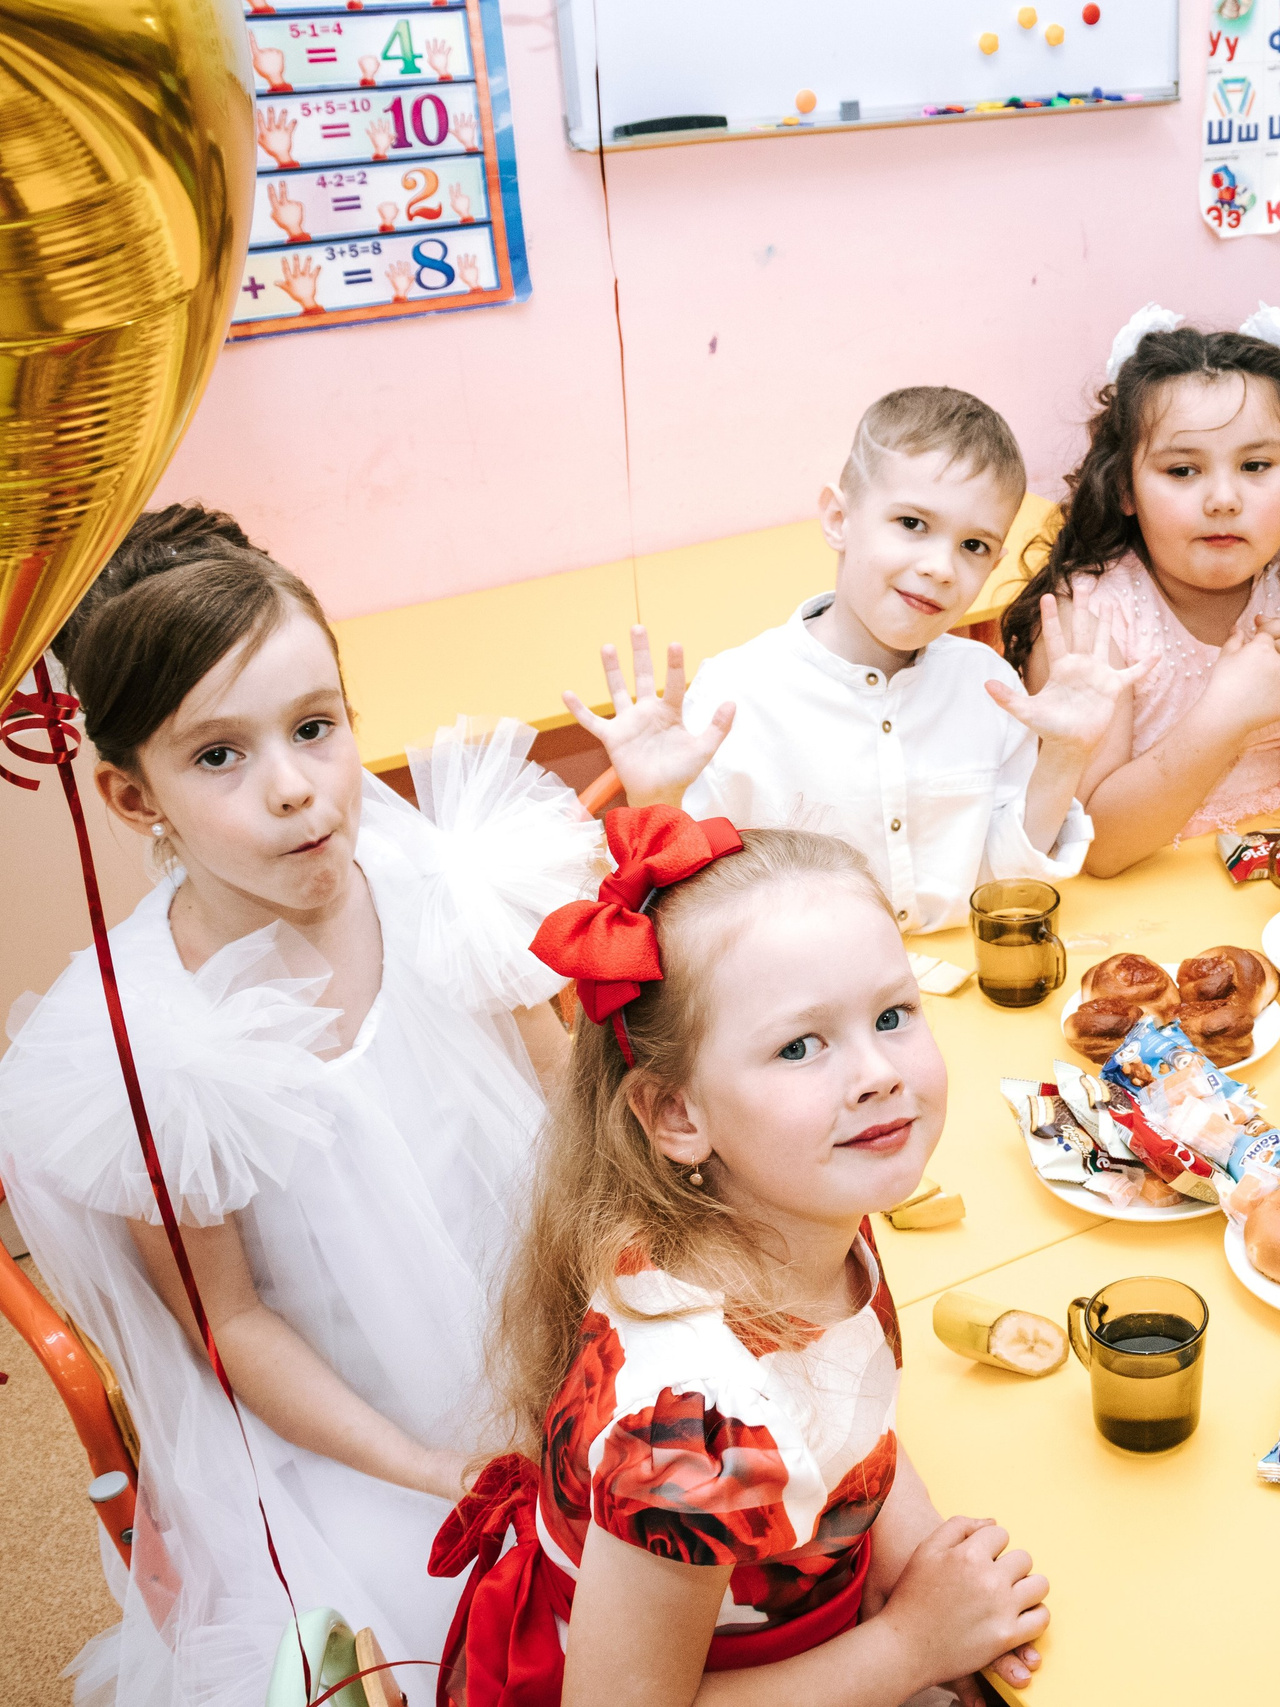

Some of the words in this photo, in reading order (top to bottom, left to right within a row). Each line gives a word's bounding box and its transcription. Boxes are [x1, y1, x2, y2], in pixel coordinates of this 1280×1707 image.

[288, 21, 344, 39] 5-1=4
[380, 19, 423, 76] 4
[300, 97, 372, 118] 5+5=10
[383, 93, 449, 150] 10
[316, 171, 368, 189] 4-2=2
[402, 167, 443, 222] 2
[325, 242, 382, 262] 3+5=8
[414, 239, 455, 291] 8
